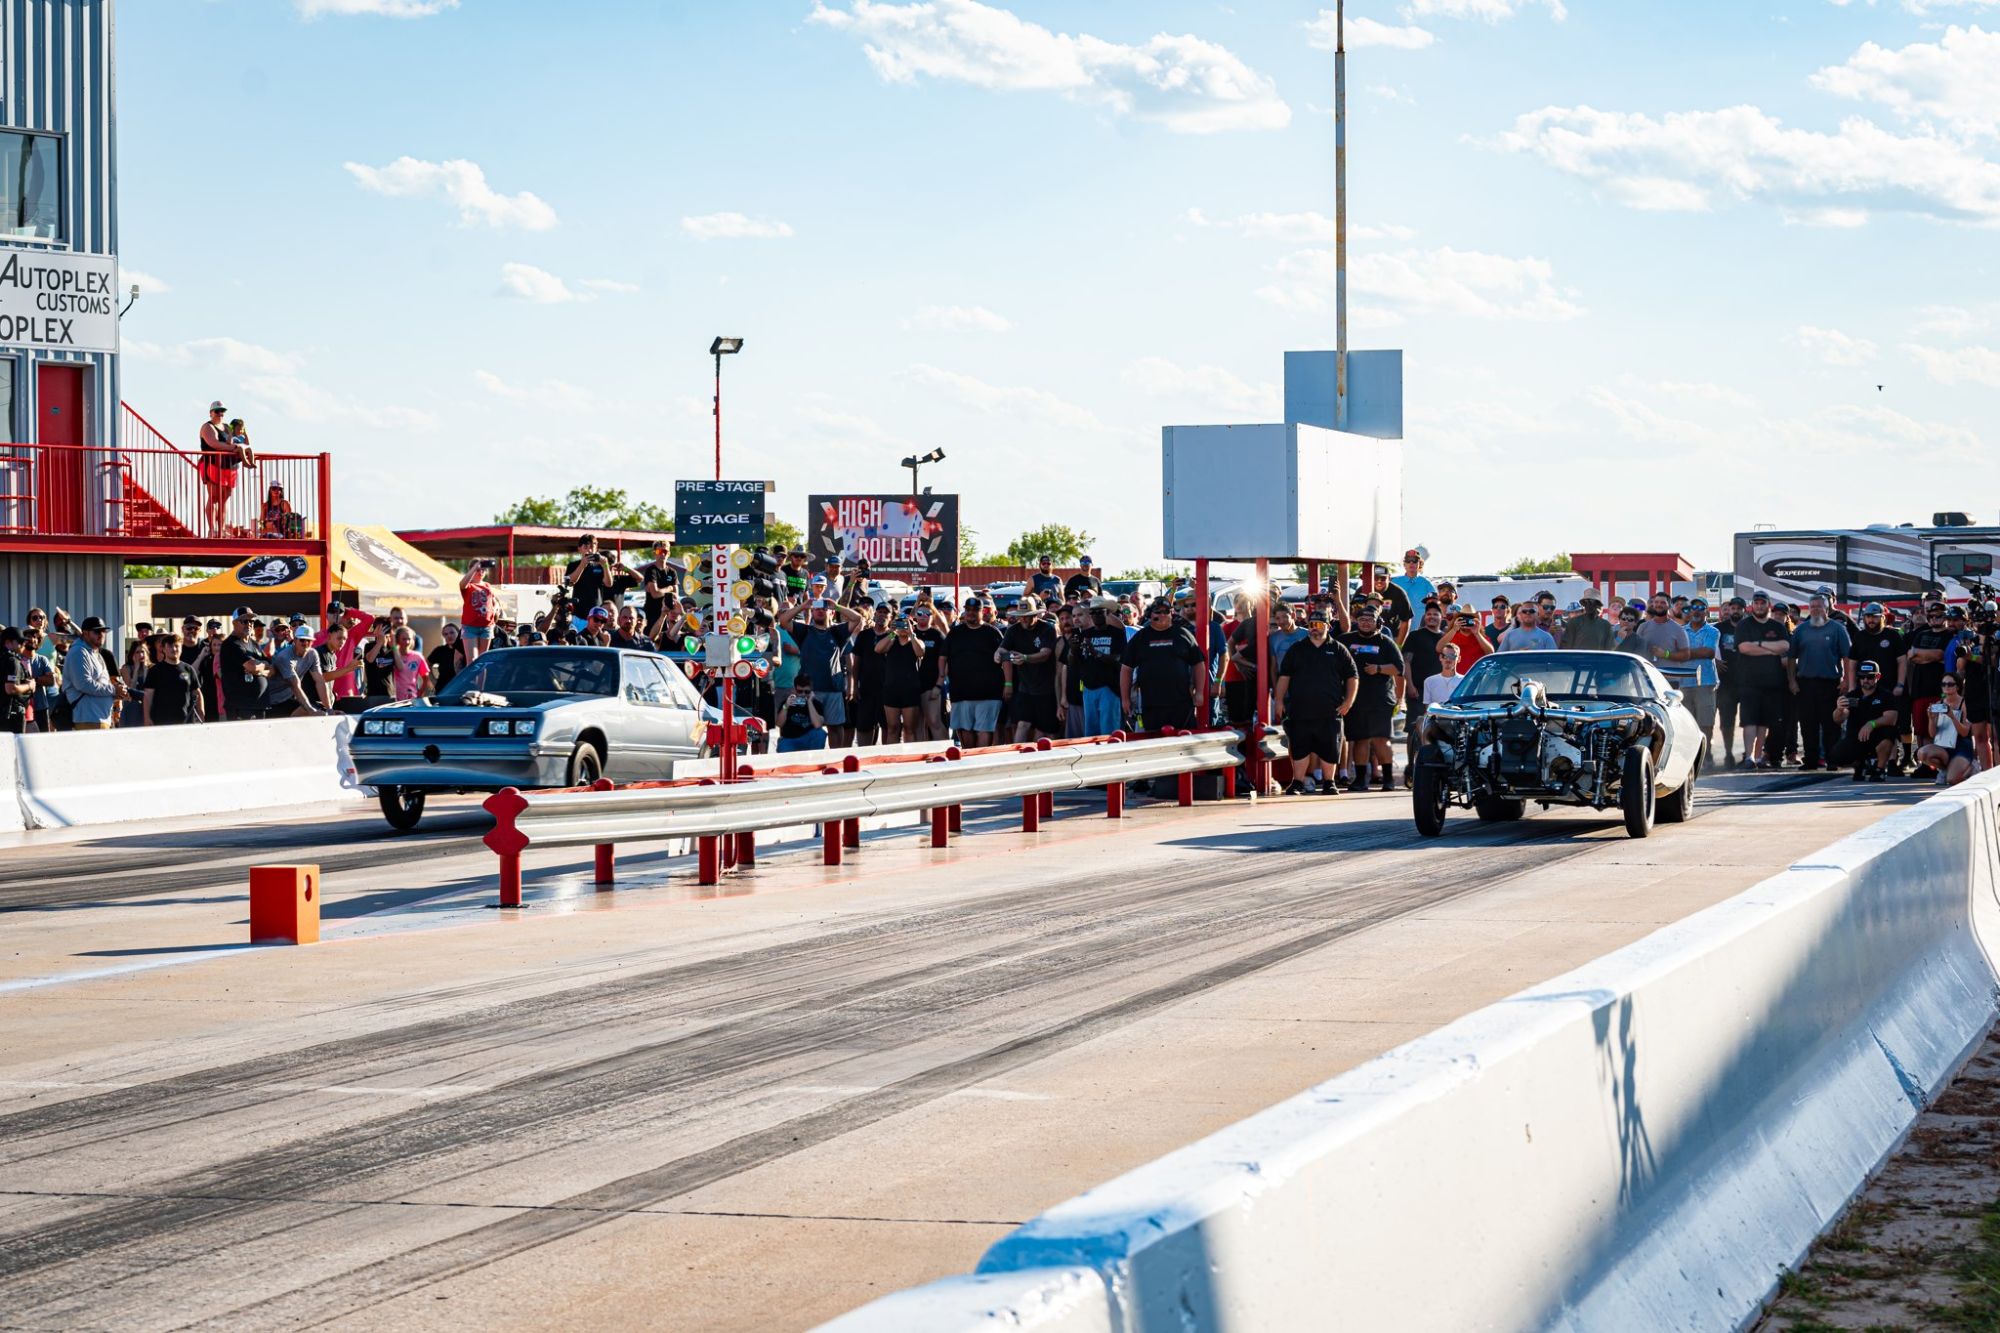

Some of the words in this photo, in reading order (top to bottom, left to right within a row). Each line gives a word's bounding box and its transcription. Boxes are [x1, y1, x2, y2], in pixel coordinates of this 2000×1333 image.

[0, 254, 110, 294] AUTOPLEX
[36, 292, 110, 315] CUSTOMS
[676, 481, 764, 492] PRE-STAGE
[690, 513, 750, 525] STAGE
[838, 499, 882, 528] HIGH
[858, 537, 921, 563] ROLLER
